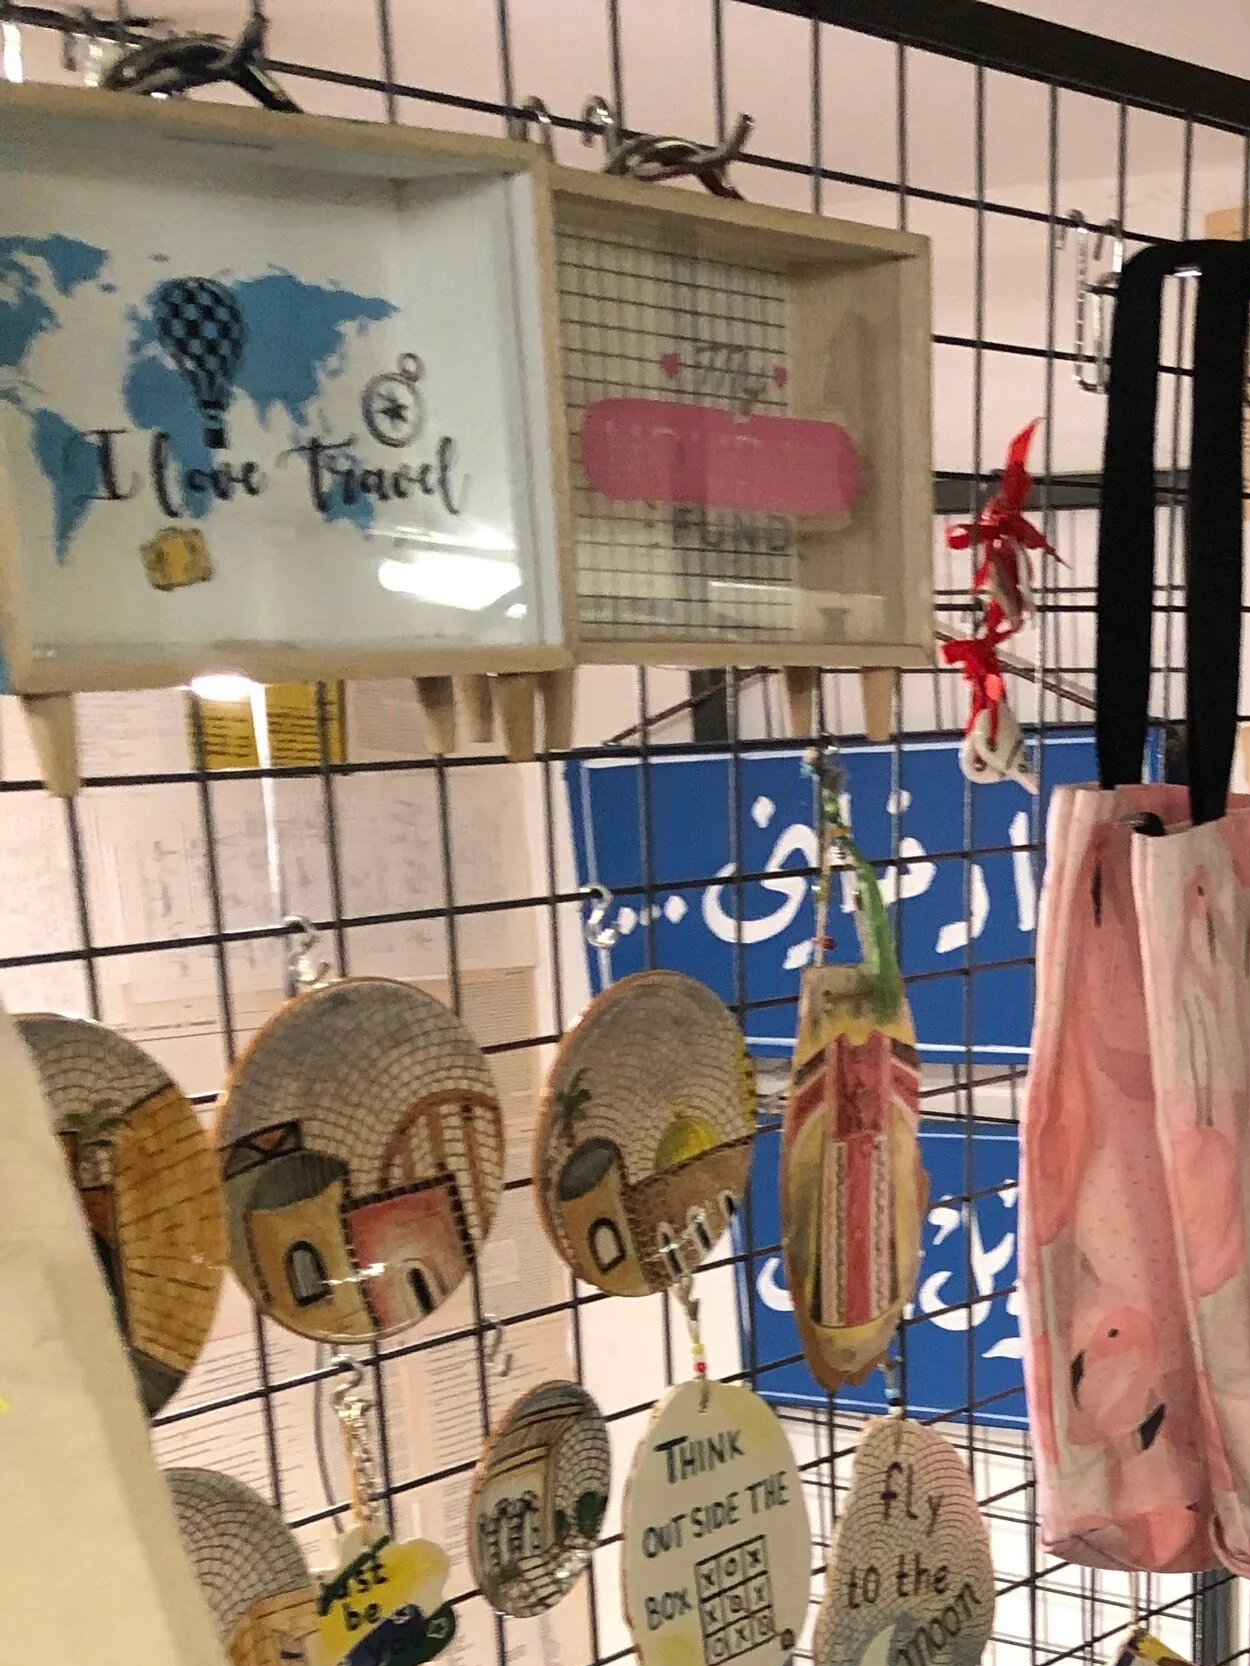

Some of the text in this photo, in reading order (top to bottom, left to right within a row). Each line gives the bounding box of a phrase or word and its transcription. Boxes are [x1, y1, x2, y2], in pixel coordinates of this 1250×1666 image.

[82, 427, 140, 501] I
[150, 431, 268, 518] love
[673, 506, 791, 552] FUND
[654, 1429, 745, 1484] THINK
[745, 1470, 790, 1515] THE
[848, 1551, 949, 1609] to the
[644, 1587, 692, 1631] BOX
